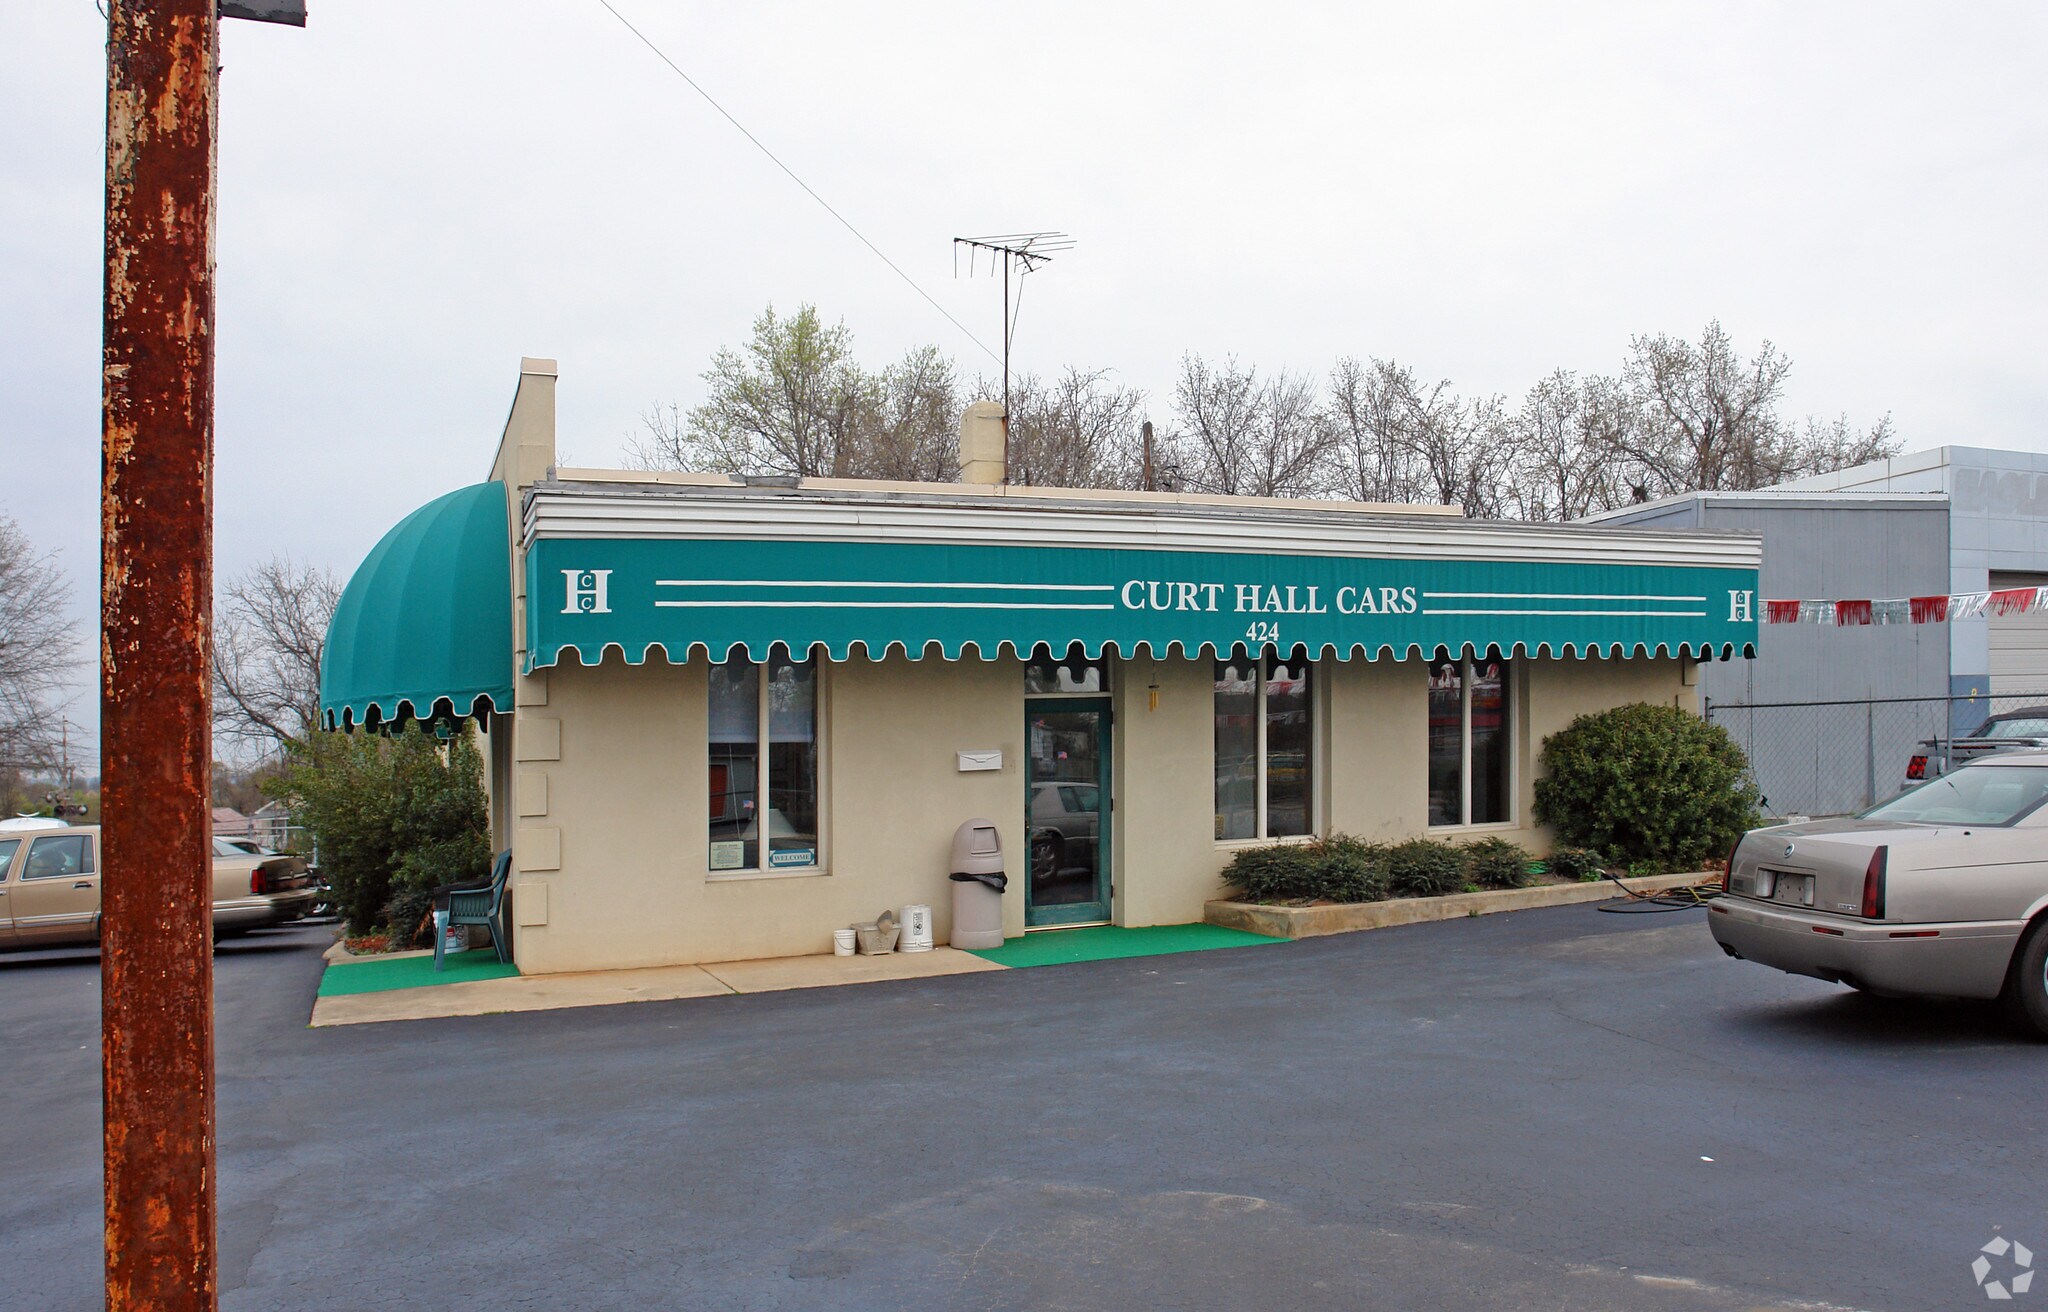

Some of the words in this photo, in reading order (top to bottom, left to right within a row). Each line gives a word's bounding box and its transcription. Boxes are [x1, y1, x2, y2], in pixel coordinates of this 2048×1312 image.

[1121, 580, 1224, 612] CURT
[1234, 584, 1327, 614] HALL
[1336, 586, 1417, 614] CARS
[1245, 621, 1280, 642] 424
